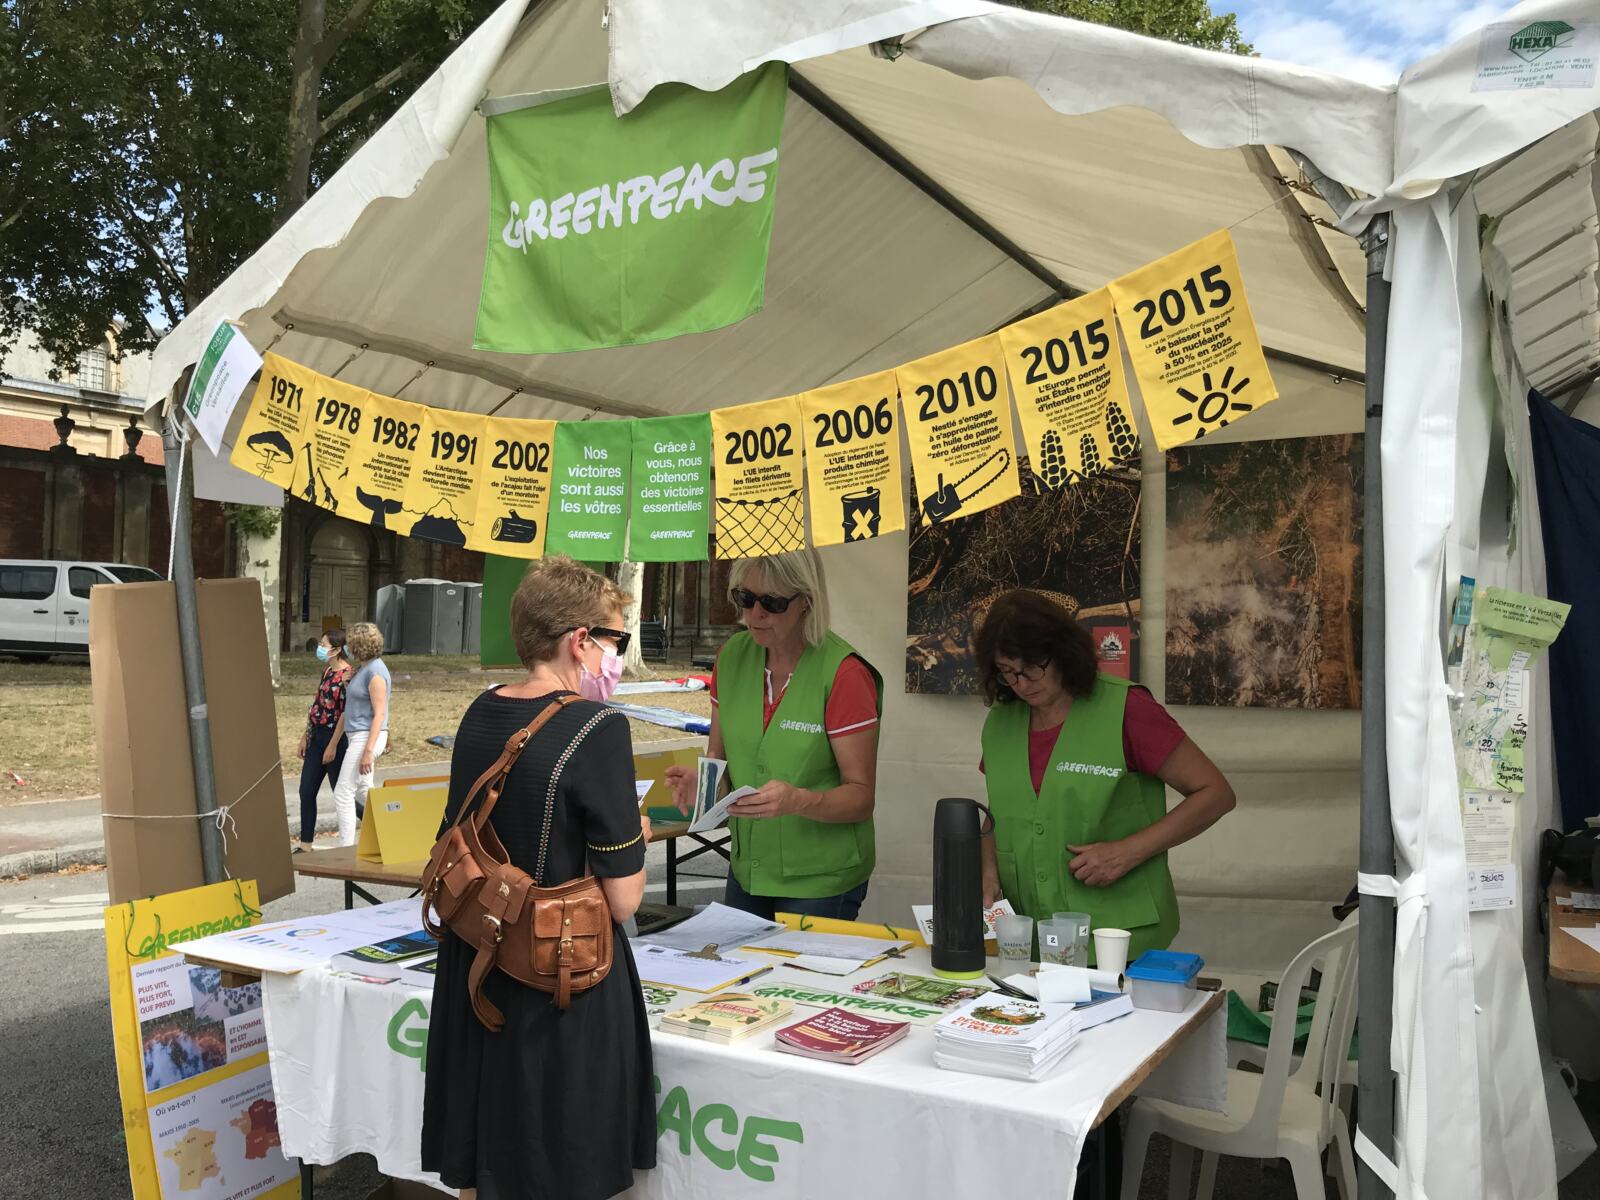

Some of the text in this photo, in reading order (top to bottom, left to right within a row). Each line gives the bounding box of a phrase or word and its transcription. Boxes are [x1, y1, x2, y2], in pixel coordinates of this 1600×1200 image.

[1512, 36, 1553, 49] HEXA
[502, 147, 778, 254] GREENPEACE
[1133, 264, 1231, 340] 2015
[1155, 346, 1166, 354] de
[1168, 331, 1199, 348] baisser
[1214, 316, 1230, 331] part
[1020, 319, 1110, 385] 2015
[1168, 332, 1223, 358] du nucléaire
[1197, 349, 1209, 357] en
[1211, 336, 1232, 351] 2025
[1038, 363, 1105, 392] L'Europe permet
[270, 376, 303, 412] 1971
[915, 365, 997, 422] 2010
[1035, 370, 1110, 403] aux États membres
[1038, 394, 1080, 411] d'interdire
[315, 397, 361, 434] 1978
[813, 397, 893, 448] 2006
[932, 410, 992, 432] Nestlé s'engage
[373, 416, 420, 451] 1982
[936, 417, 997, 439] s'approvisionner
[943, 437, 961, 446] huile
[975, 425, 998, 438] palme
[431, 430, 477, 465] 1991
[654, 440, 696, 453] Grâce à
[725, 423, 793, 465] 2002
[492, 440, 549, 472] 2002
[584, 446, 608, 460] Nos
[829, 456, 845, 465] L'UE
[847, 451, 873, 461] interdit
[435, 465, 467, 474] L'Antarctique
[646, 456, 702, 469] vous, nous
[824, 464, 853, 475] produits
[423, 469, 445, 478] devient
[568, 464, 622, 478] victoires
[649, 471, 699, 483] obtenons
[743, 465, 780, 476] L'UE interdit
[761, 472, 790, 481] dérivants
[422, 477, 448, 485] naturelle
[501, 482, 523, 491] l'acajou
[505, 475, 539, 484] L'exploitation
[515, 490, 539, 498] moratoire
[560, 482, 624, 496] sont aussi
[641, 485, 704, 498] des victoires
[560, 499, 621, 514] les vôtres
[643, 500, 702, 513] essentielles
[568, 530, 613, 540] GREENPEACE
[650, 529, 695, 540] GREENPEACE
[1056, 762, 1122, 778] GREENPEACE
[1050, 936, 1056, 944] 2
[138, 980, 169, 994] PLUS VITE,
[139, 989, 173, 1005] PLUS FORT,
[754, 986, 943, 1019] GREENPEACE
[140, 1004, 154, 1015] QUE
[155, 1108, 166, 1116] Où
[167, 1098, 191, 1112] va-t-on
